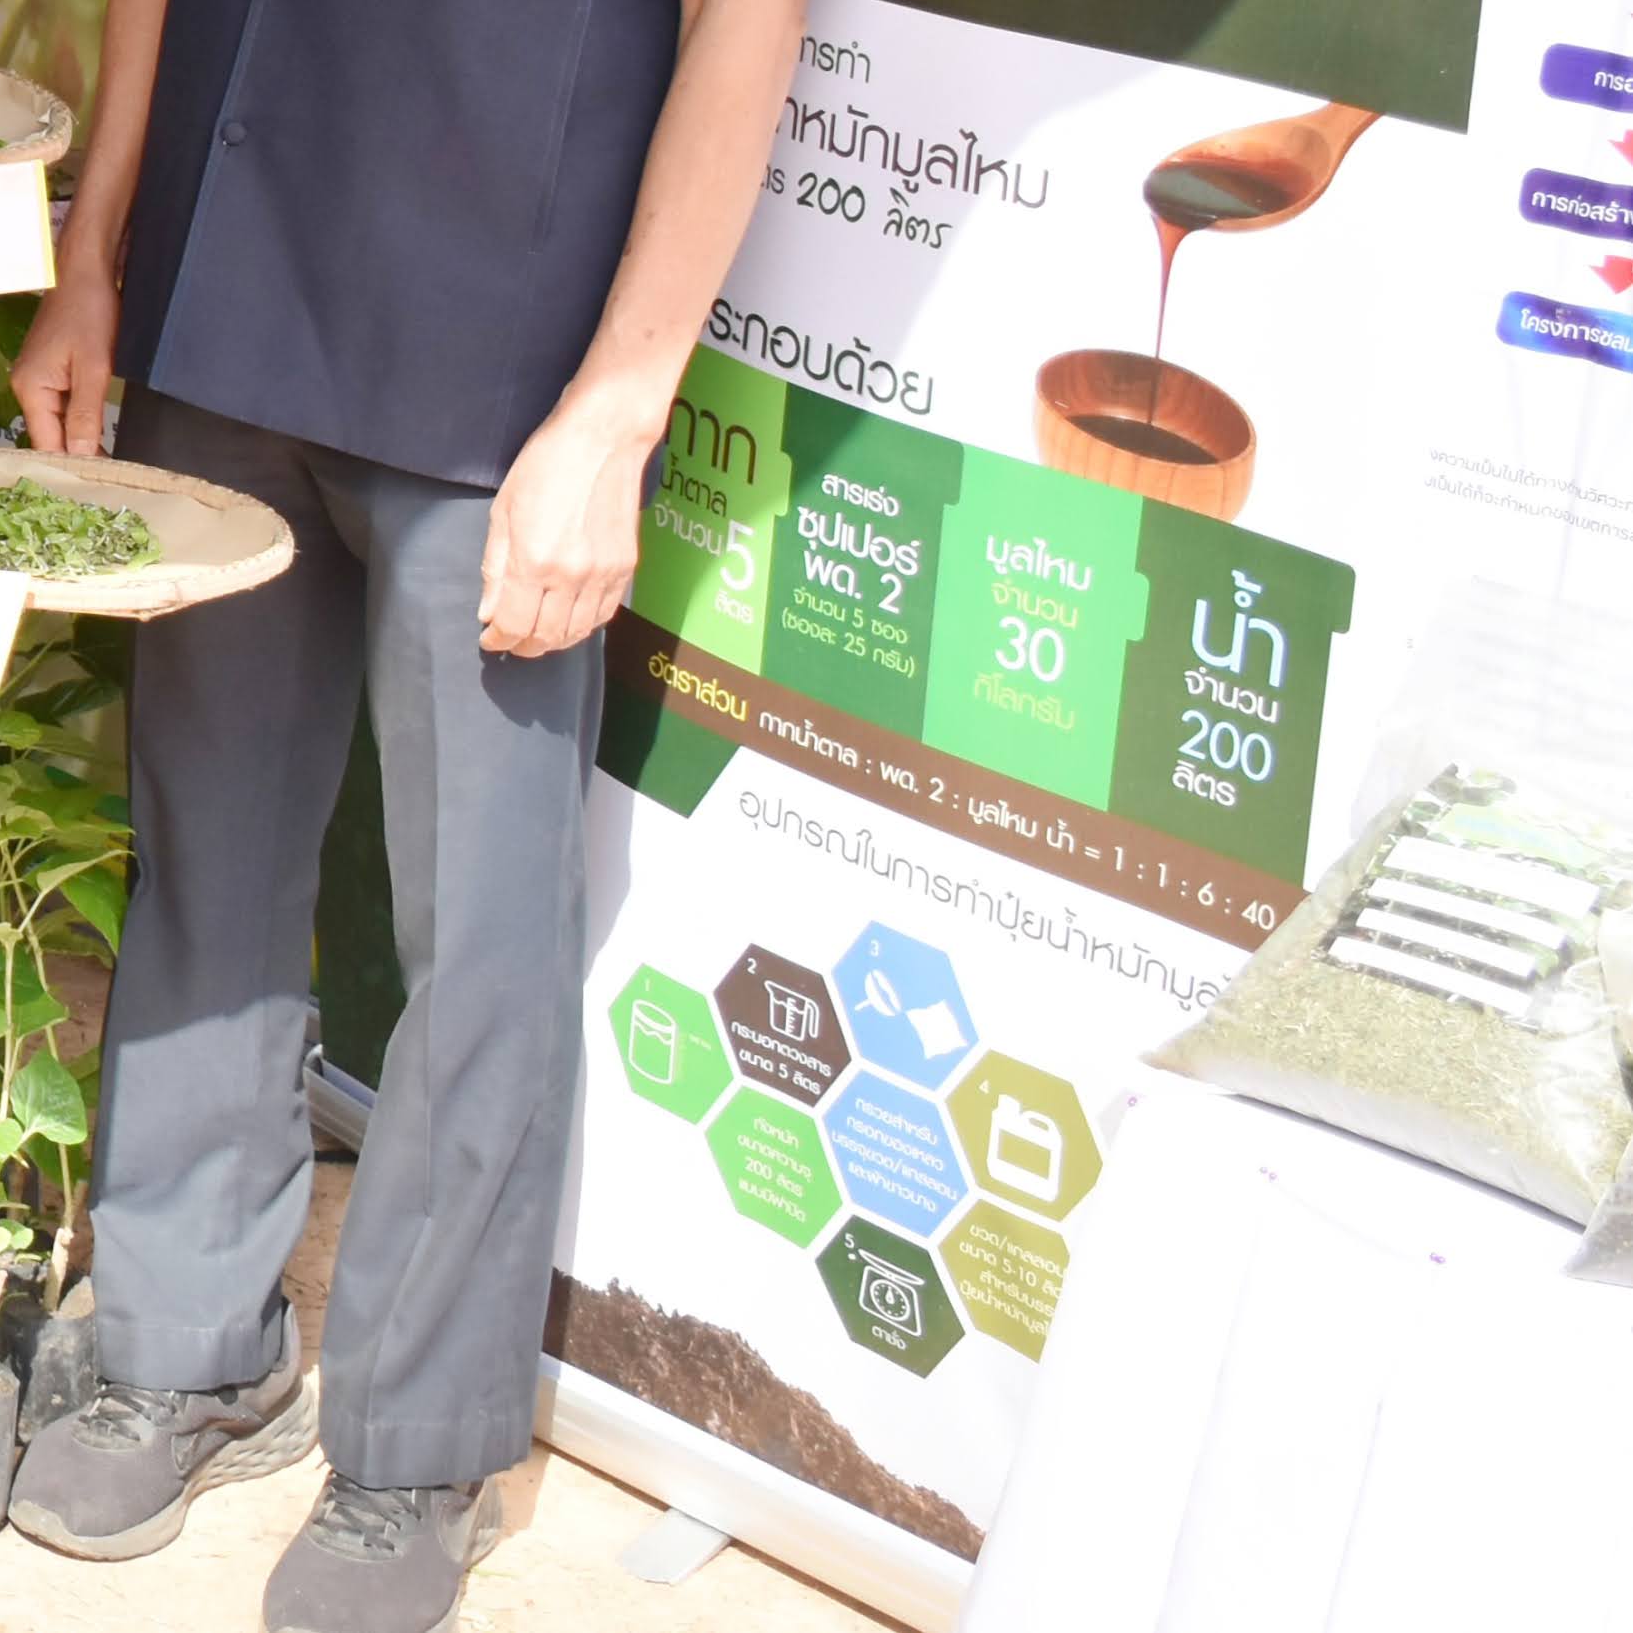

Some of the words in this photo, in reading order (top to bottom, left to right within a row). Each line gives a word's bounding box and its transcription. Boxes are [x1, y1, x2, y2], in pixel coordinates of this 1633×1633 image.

[796, 171, 866, 224] 200
[882, 186, 954, 250] ลิตร
[709, 297, 934, 416] ระกอบด้วย
[666, 396, 757, 485] กาก
[659, 454, 728, 517] น้ำตาล
[821, 472, 900, 518] สารเร่ง
[654, 502, 725, 557] จำนวน
[719, 519, 756, 592] 5
[796, 505, 923, 577] ซุปเปอร์
[985, 529, 1093, 594] มูลไหม
[714, 590, 755, 625] ลิตร
[803, 549, 862, 599] พด.
[878, 574, 904, 614] 2
[991, 579, 1079, 632] จำนวน
[793, 587, 846, 623] จำนวน
[852, 607, 865, 629] 5
[870, 618, 909, 645] ซอง
[1190, 569, 1290, 690] น้ำ
[843, 631, 867, 658] 25
[872, 646, 917, 678] กรัม)
[993, 615, 1067, 684] 30
[973, 671, 1078, 733] กิโลกรัม
[1183, 666, 1279, 727] จำนวน
[1177, 710, 1277, 783] 200
[647, 651, 749, 721] อัตราส่วน
[759, 712, 859, 770] กากน้ำตาล
[880, 761, 921, 796] พด.
[928, 776, 946, 807] 2
[967, 791, 1038, 841] มูลไหม
[1045, 814, 1076, 856] น้ำ
[1112, 846, 1125, 872] 1
[1157, 863, 1168, 888] 1
[1197, 881, 1216, 908] 6
[1239, 900, 1276, 932] 40
[1171, 759, 1239, 808] ลิตร
[747, 958, 757, 975] 2
[869, 940, 880, 957] 3
[731, 1021, 832, 1078] กระบอกตวงสาร
[738, 1048, 774, 1073] ขนาด
[778, 1064, 788, 1079] 5
[793, 1071, 822, 1096] ลิตร
[978, 1078, 991, 1096] 4
[744, 1157, 773, 1180] 200
[845, 1233, 855, 1250] 5
